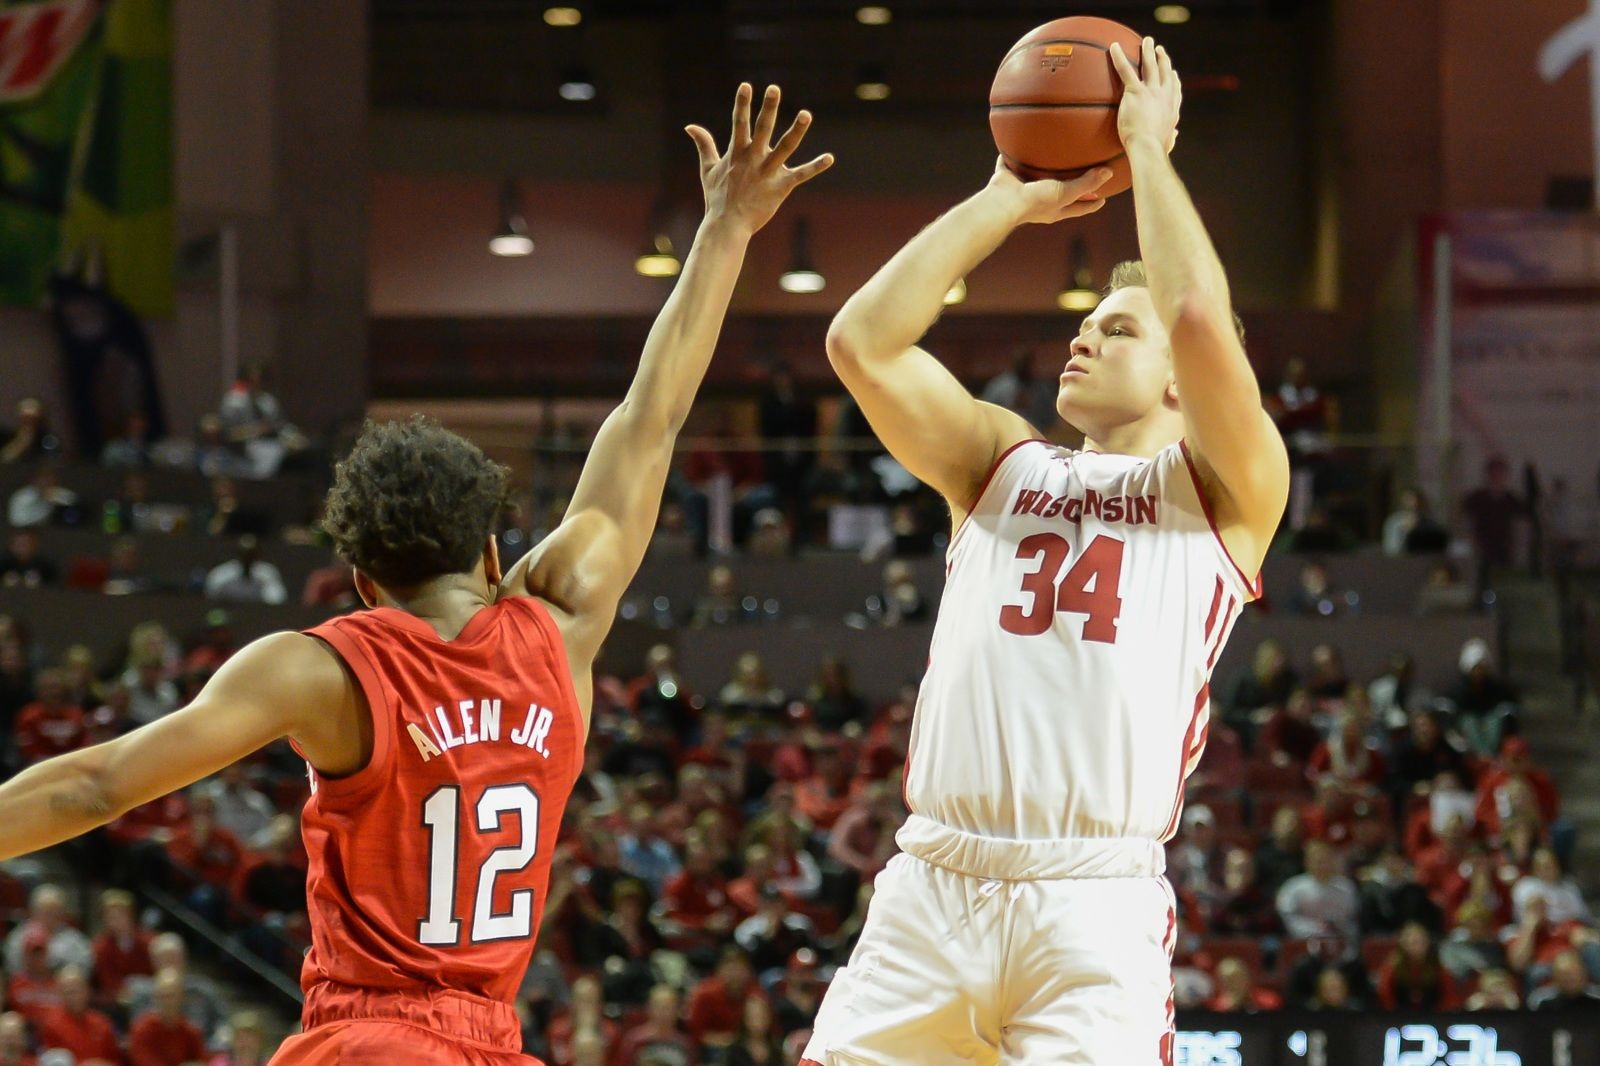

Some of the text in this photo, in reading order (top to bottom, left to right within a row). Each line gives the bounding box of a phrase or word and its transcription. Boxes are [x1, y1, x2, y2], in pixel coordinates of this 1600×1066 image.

[1012, 488, 1157, 526] WISCNSIN
[998, 532, 1125, 644] 34
[510, 703, 554, 759] JR.
[418, 783, 540, 946] 12
